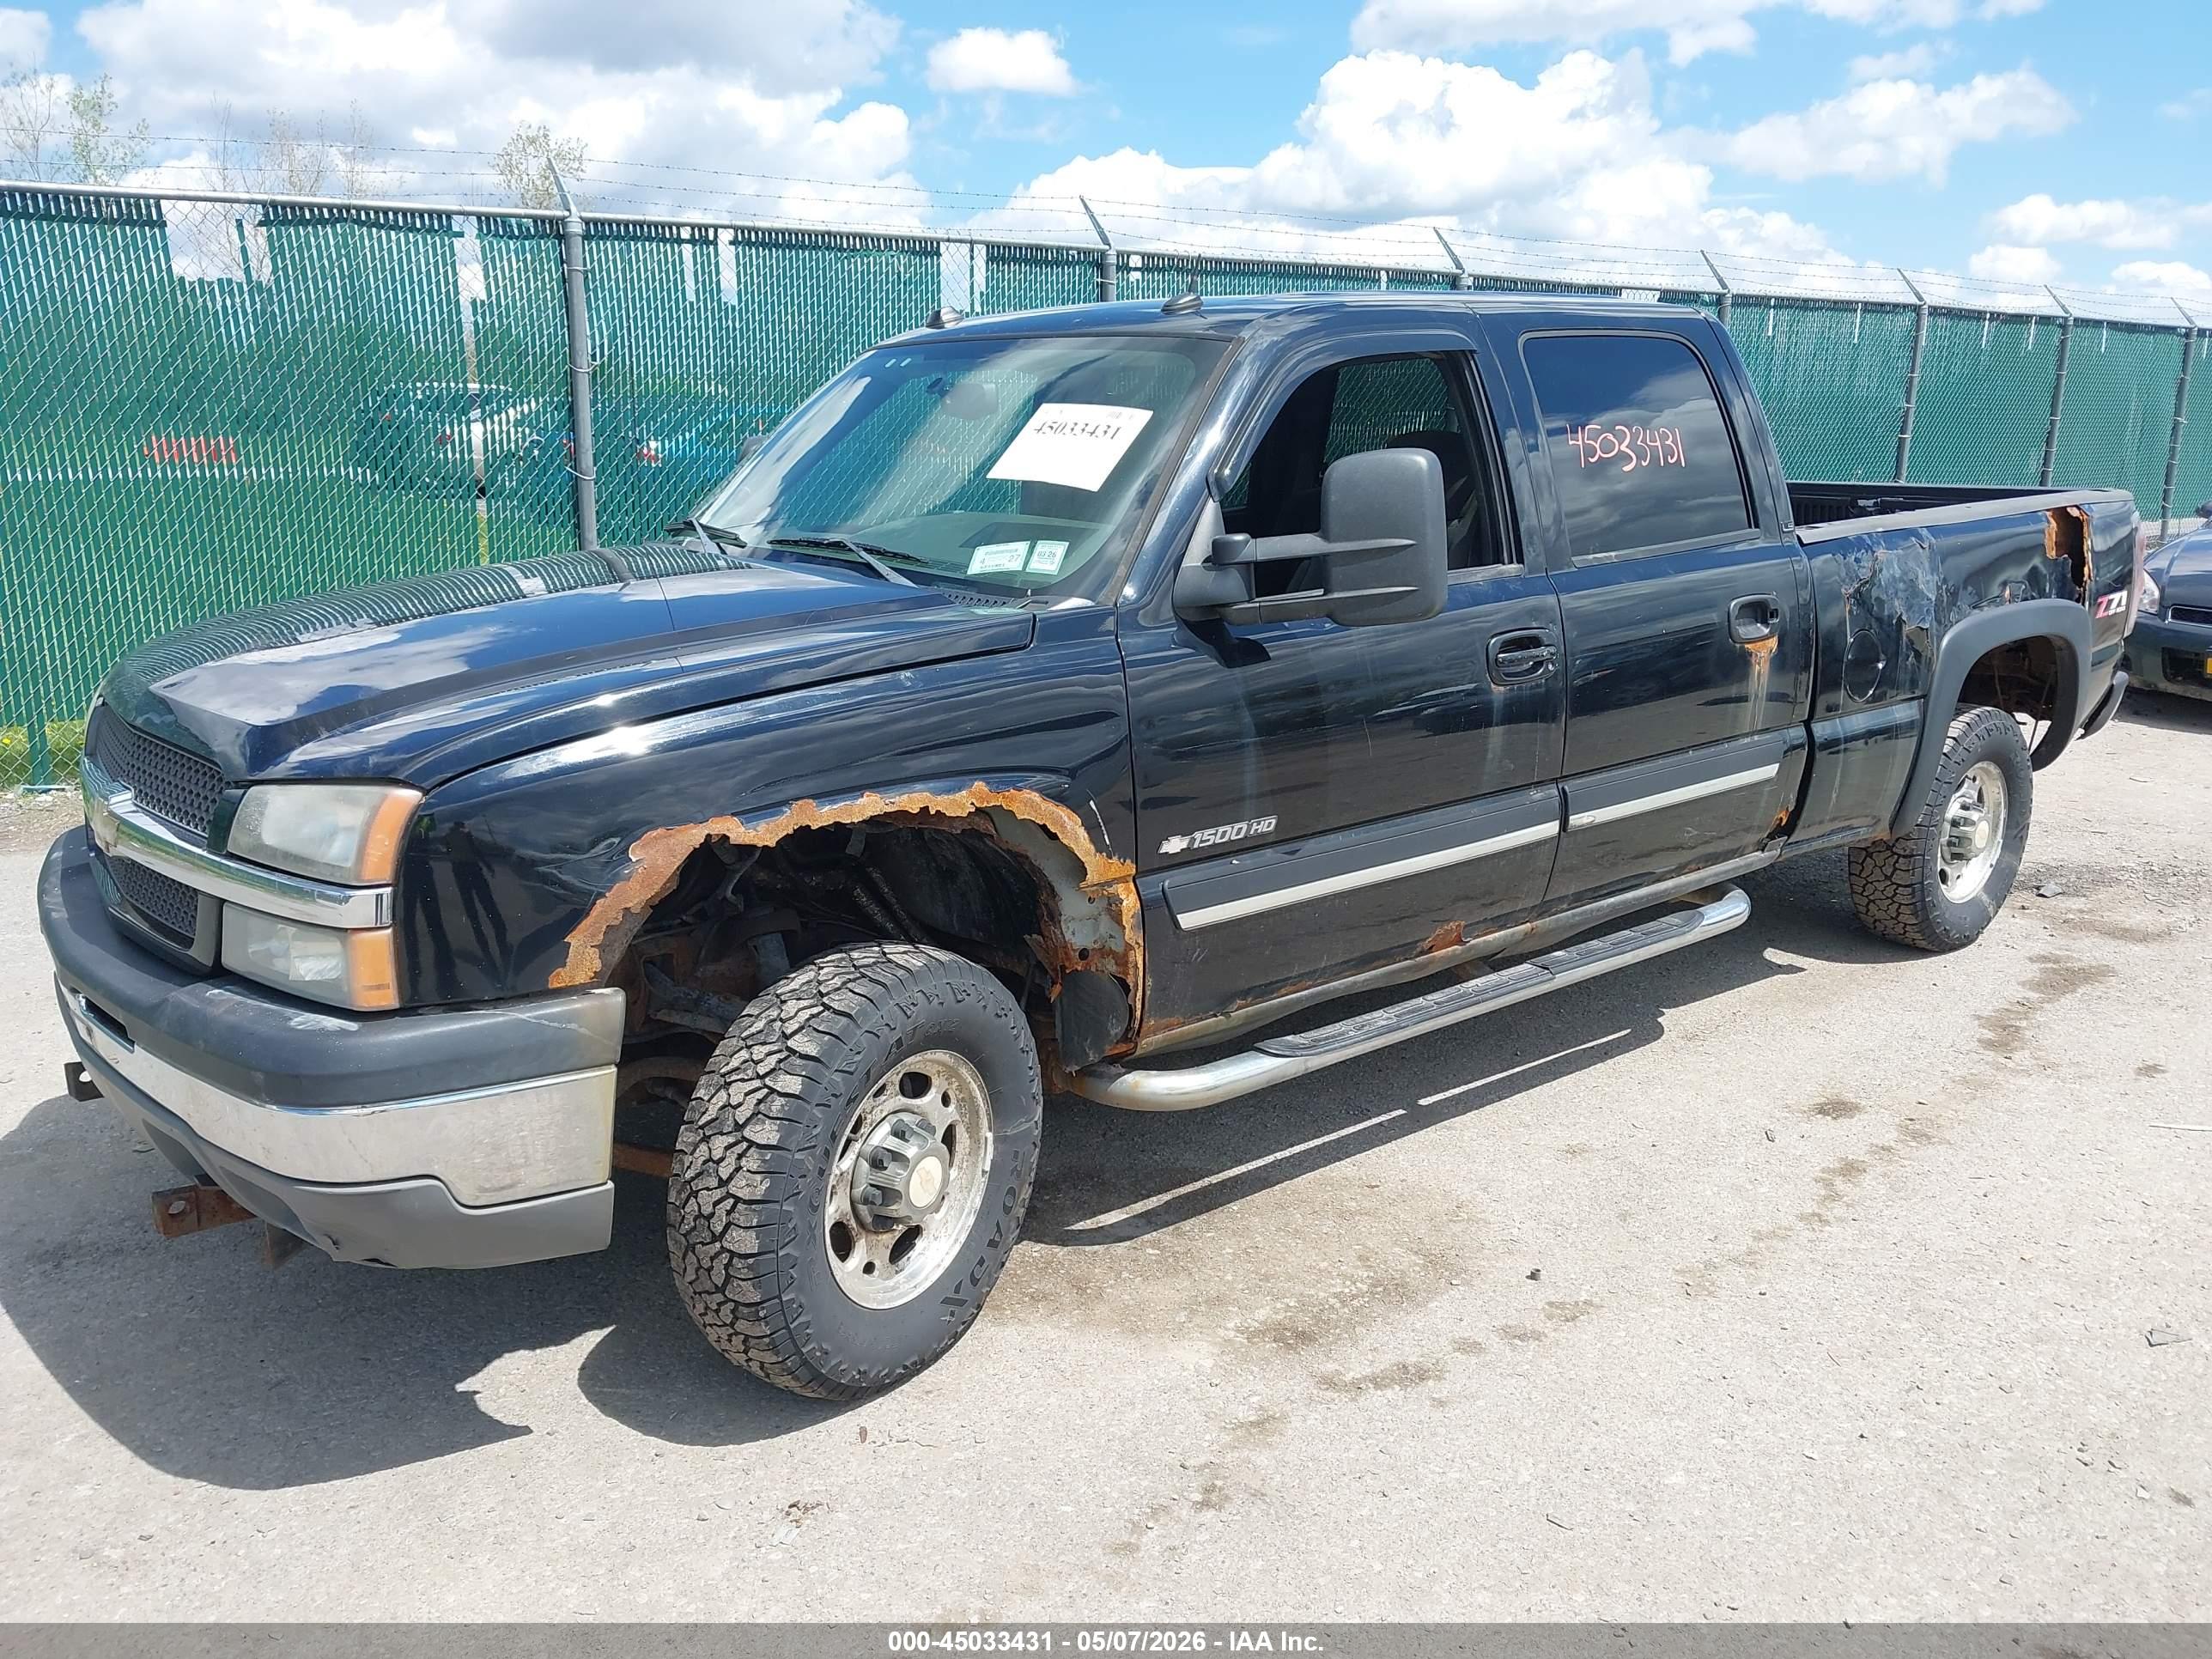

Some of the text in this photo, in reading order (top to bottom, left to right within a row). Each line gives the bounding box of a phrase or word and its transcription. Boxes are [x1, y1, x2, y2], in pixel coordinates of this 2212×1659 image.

[1033, 421, 1121, 440] 45033431
[1565, 423, 1686, 472] 45033431
[2095, 590, 2128, 618] Z71
[1193, 818, 1276, 848] 1500 HD
